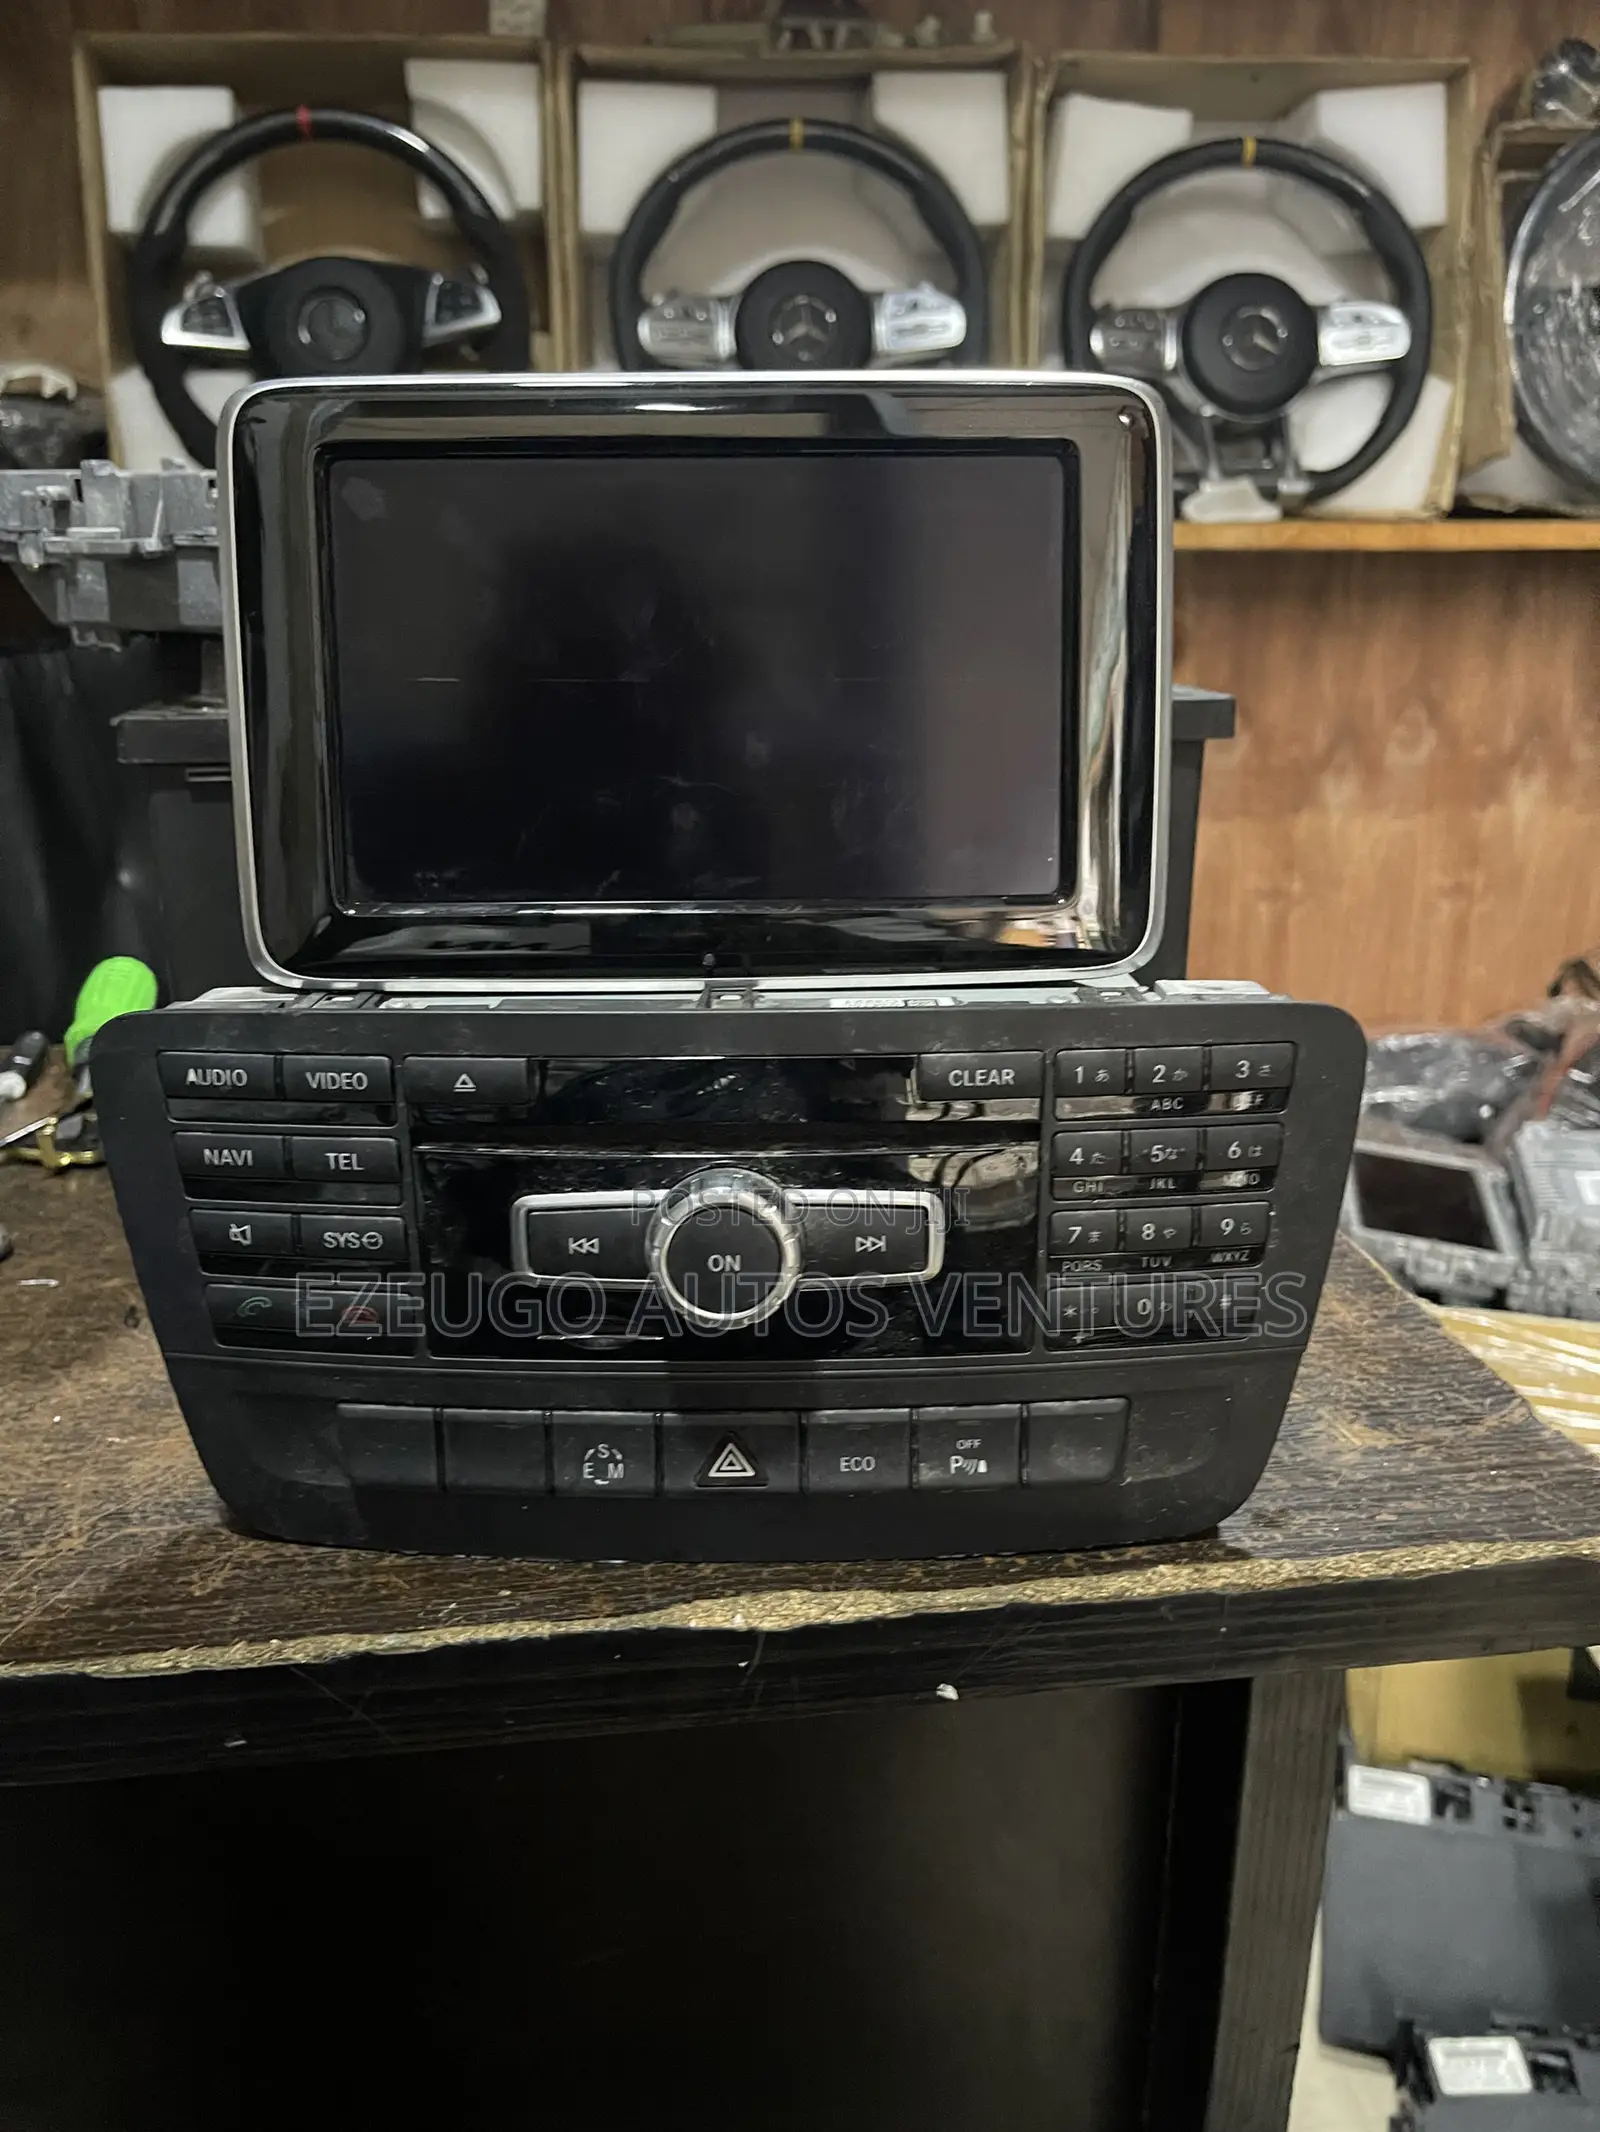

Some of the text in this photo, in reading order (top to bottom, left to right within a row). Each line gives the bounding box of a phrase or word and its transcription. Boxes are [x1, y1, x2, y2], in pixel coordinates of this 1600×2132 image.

[185, 1068, 249, 1087] AUDIO
[947, 1068, 1016, 1088] CLEAR
[1073, 1065, 1085, 1084] 1
[1151, 1064, 1167, 1083] 2
[1234, 1059, 1251, 1079] 3
[304, 1071, 369, 1091] VIDEO
[1149, 1096, 1184, 1112] ABC
[203, 1148, 254, 1167] NAVI
[1068, 1146, 1085, 1165] 4
[1150, 1144, 1165, 1163] 5
[1227, 1140, 1242, 1160] 6
[324, 1152, 365, 1171] TEL
[1072, 1180, 1105, 1194] GHI
[1148, 1177, 1178, 1190] JKL
[1067, 1225, 1082, 1244] 7
[1141, 1223, 1157, 1241] 8
[1219, 1218, 1236, 1236] 9
[322, 1230, 361, 1249] SYS
[707, 1253, 741, 1273] ON
[1141, 1255, 1173, 1268] TUV
[597, 1443, 610, 1459] S
[955, 1437, 982, 1450] OFF
[582, 1462, 624, 1479] E M
[839, 1456, 876, 1472] ECO
